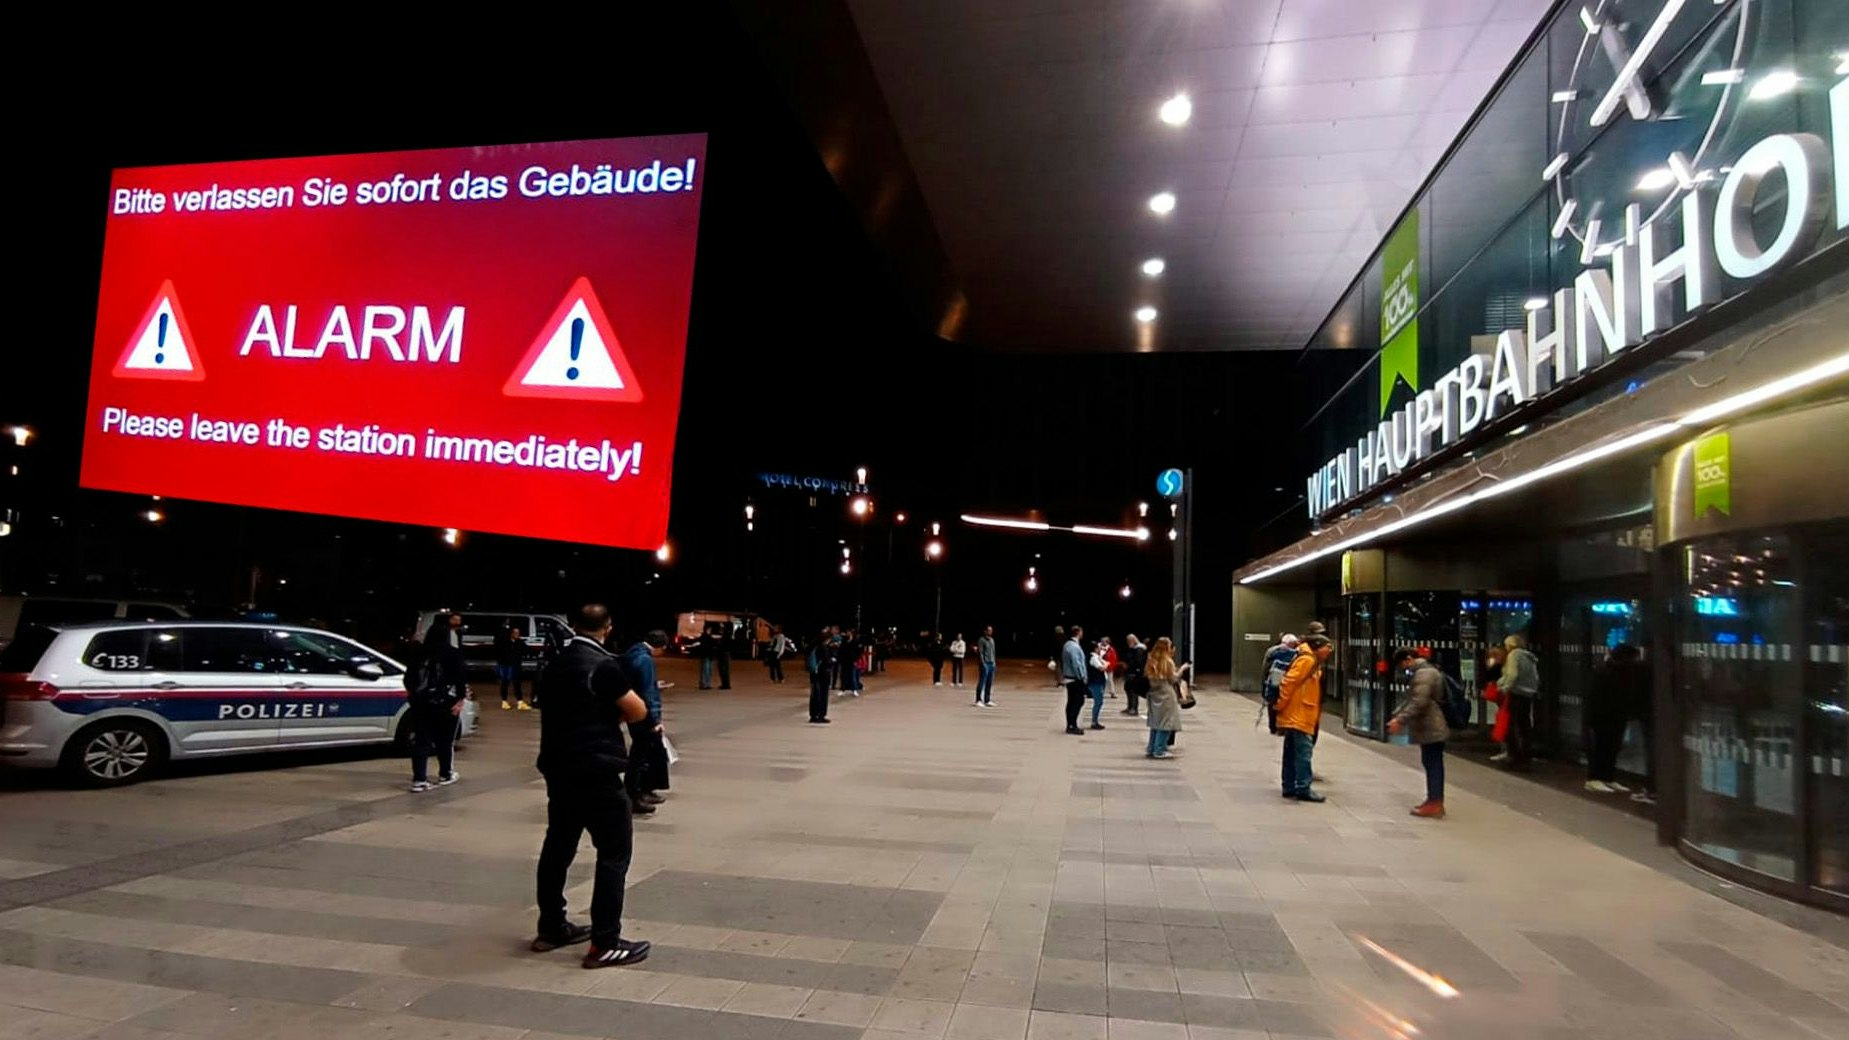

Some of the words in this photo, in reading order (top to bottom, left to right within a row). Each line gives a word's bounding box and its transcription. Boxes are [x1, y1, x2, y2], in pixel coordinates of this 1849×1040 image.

[113, 187, 166, 215] Bitte
[172, 183, 294, 211] verlassen
[302, 175, 347, 207] Sie
[355, 174, 442, 203] sofort
[449, 169, 508, 200] das
[518, 158, 697, 197] Gebäude!
[1307, 447, 1357, 519] WIEN
[1357, 75, 1849, 493] HAUPTBAHNHO
[239, 304, 466, 363] ALARM
[103, 407, 184, 438] Please
[190, 413, 260, 443] leave
[266, 417, 311, 449] the
[317, 422, 417, 457] station
[425, 432, 644, 482] immediately!
[108, 655, 139, 669] 133
[219, 703, 324, 719] POLIZEI
